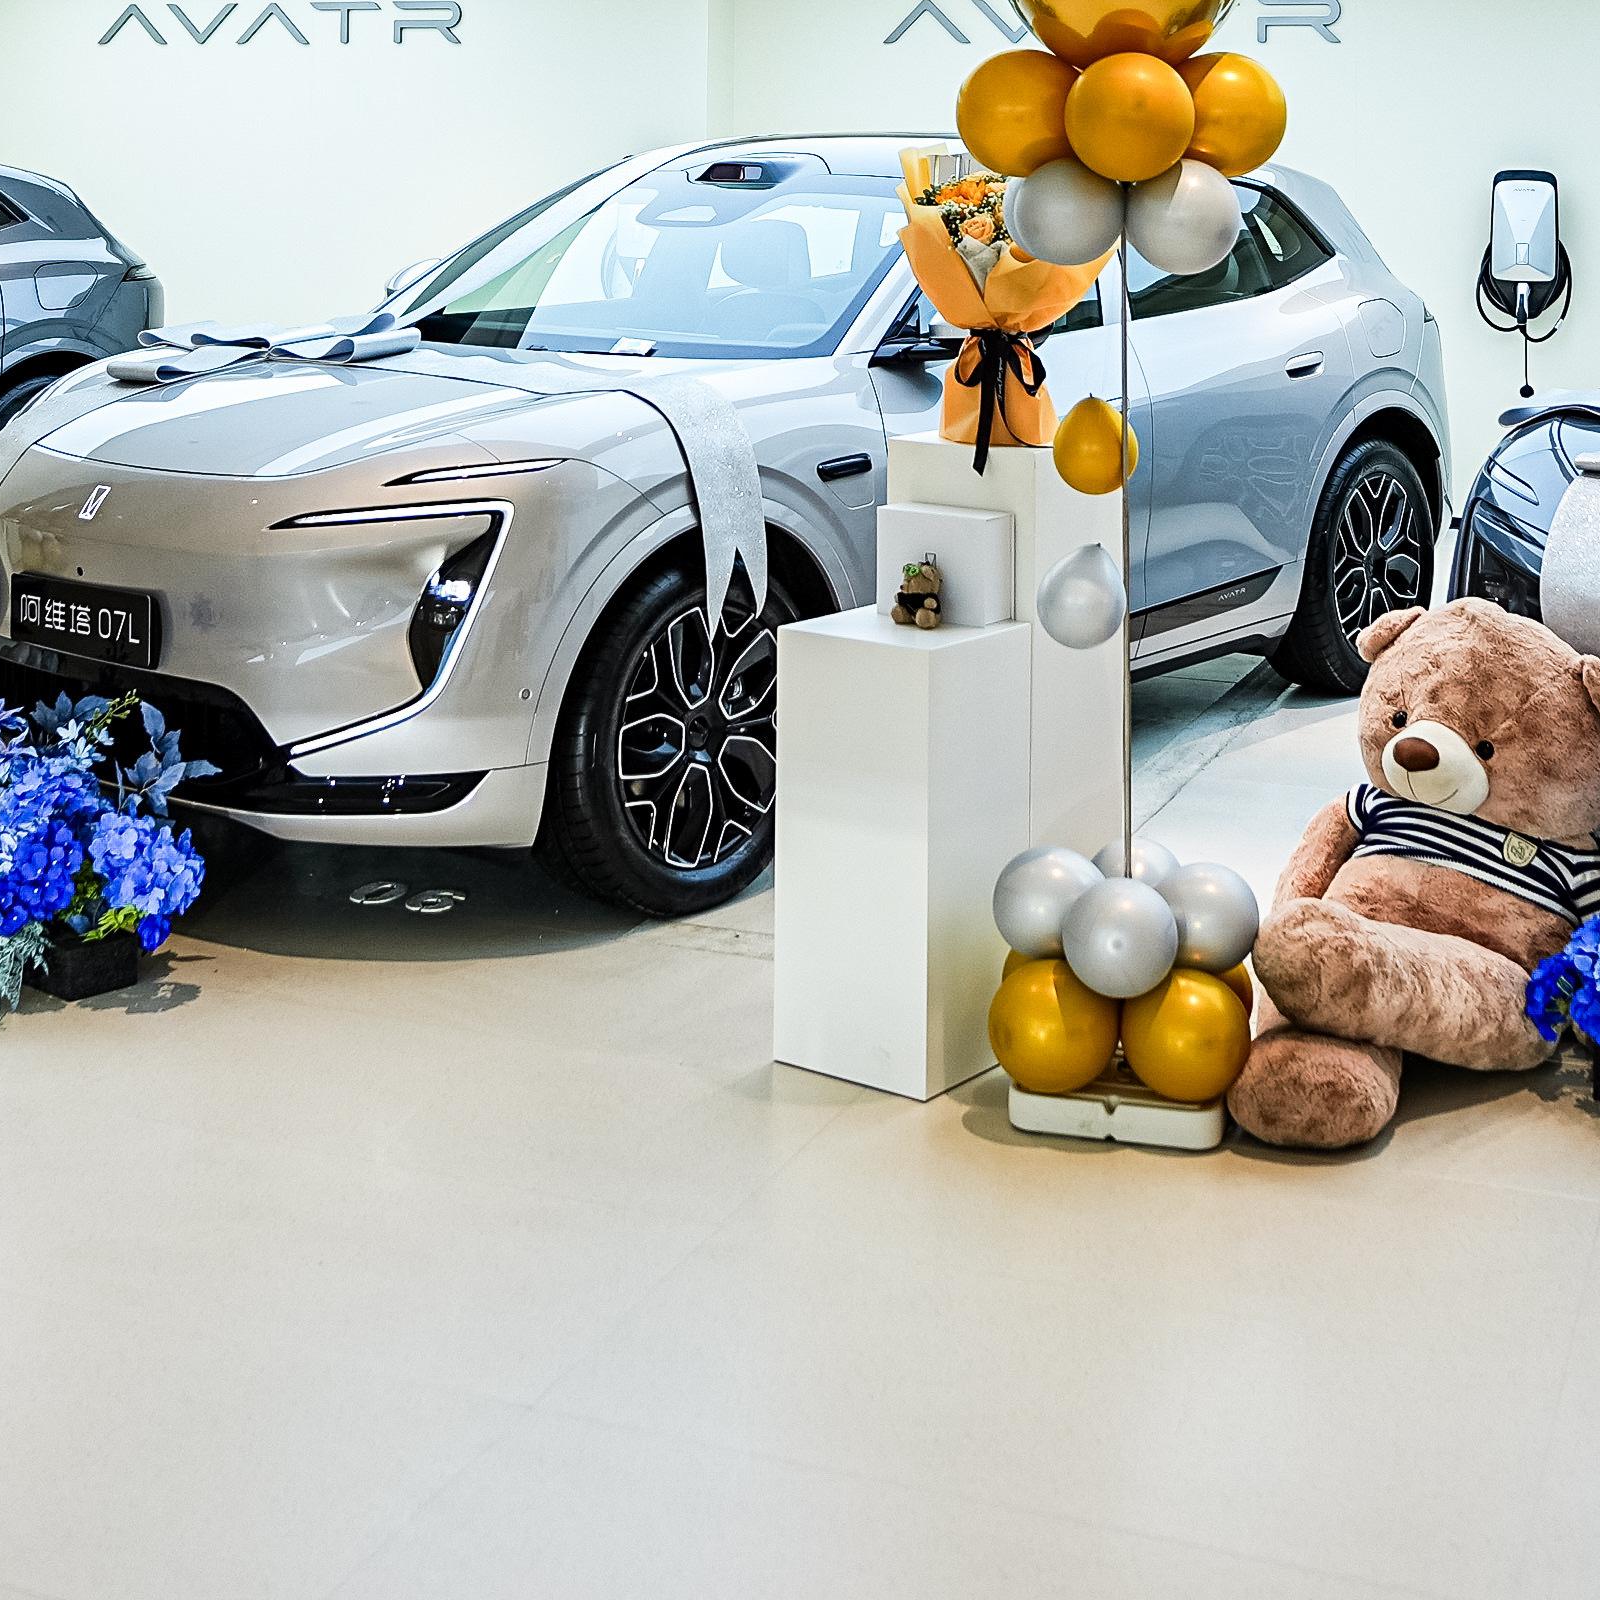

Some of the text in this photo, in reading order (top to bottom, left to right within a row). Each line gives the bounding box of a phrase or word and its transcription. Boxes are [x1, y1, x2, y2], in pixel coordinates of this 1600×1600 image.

[98, 0, 463, 45] AVATR
[1218, 587, 1246, 601] AVATR
[20, 593, 140, 644] 阿维塔 07L
[349, 881, 466, 912] 06
